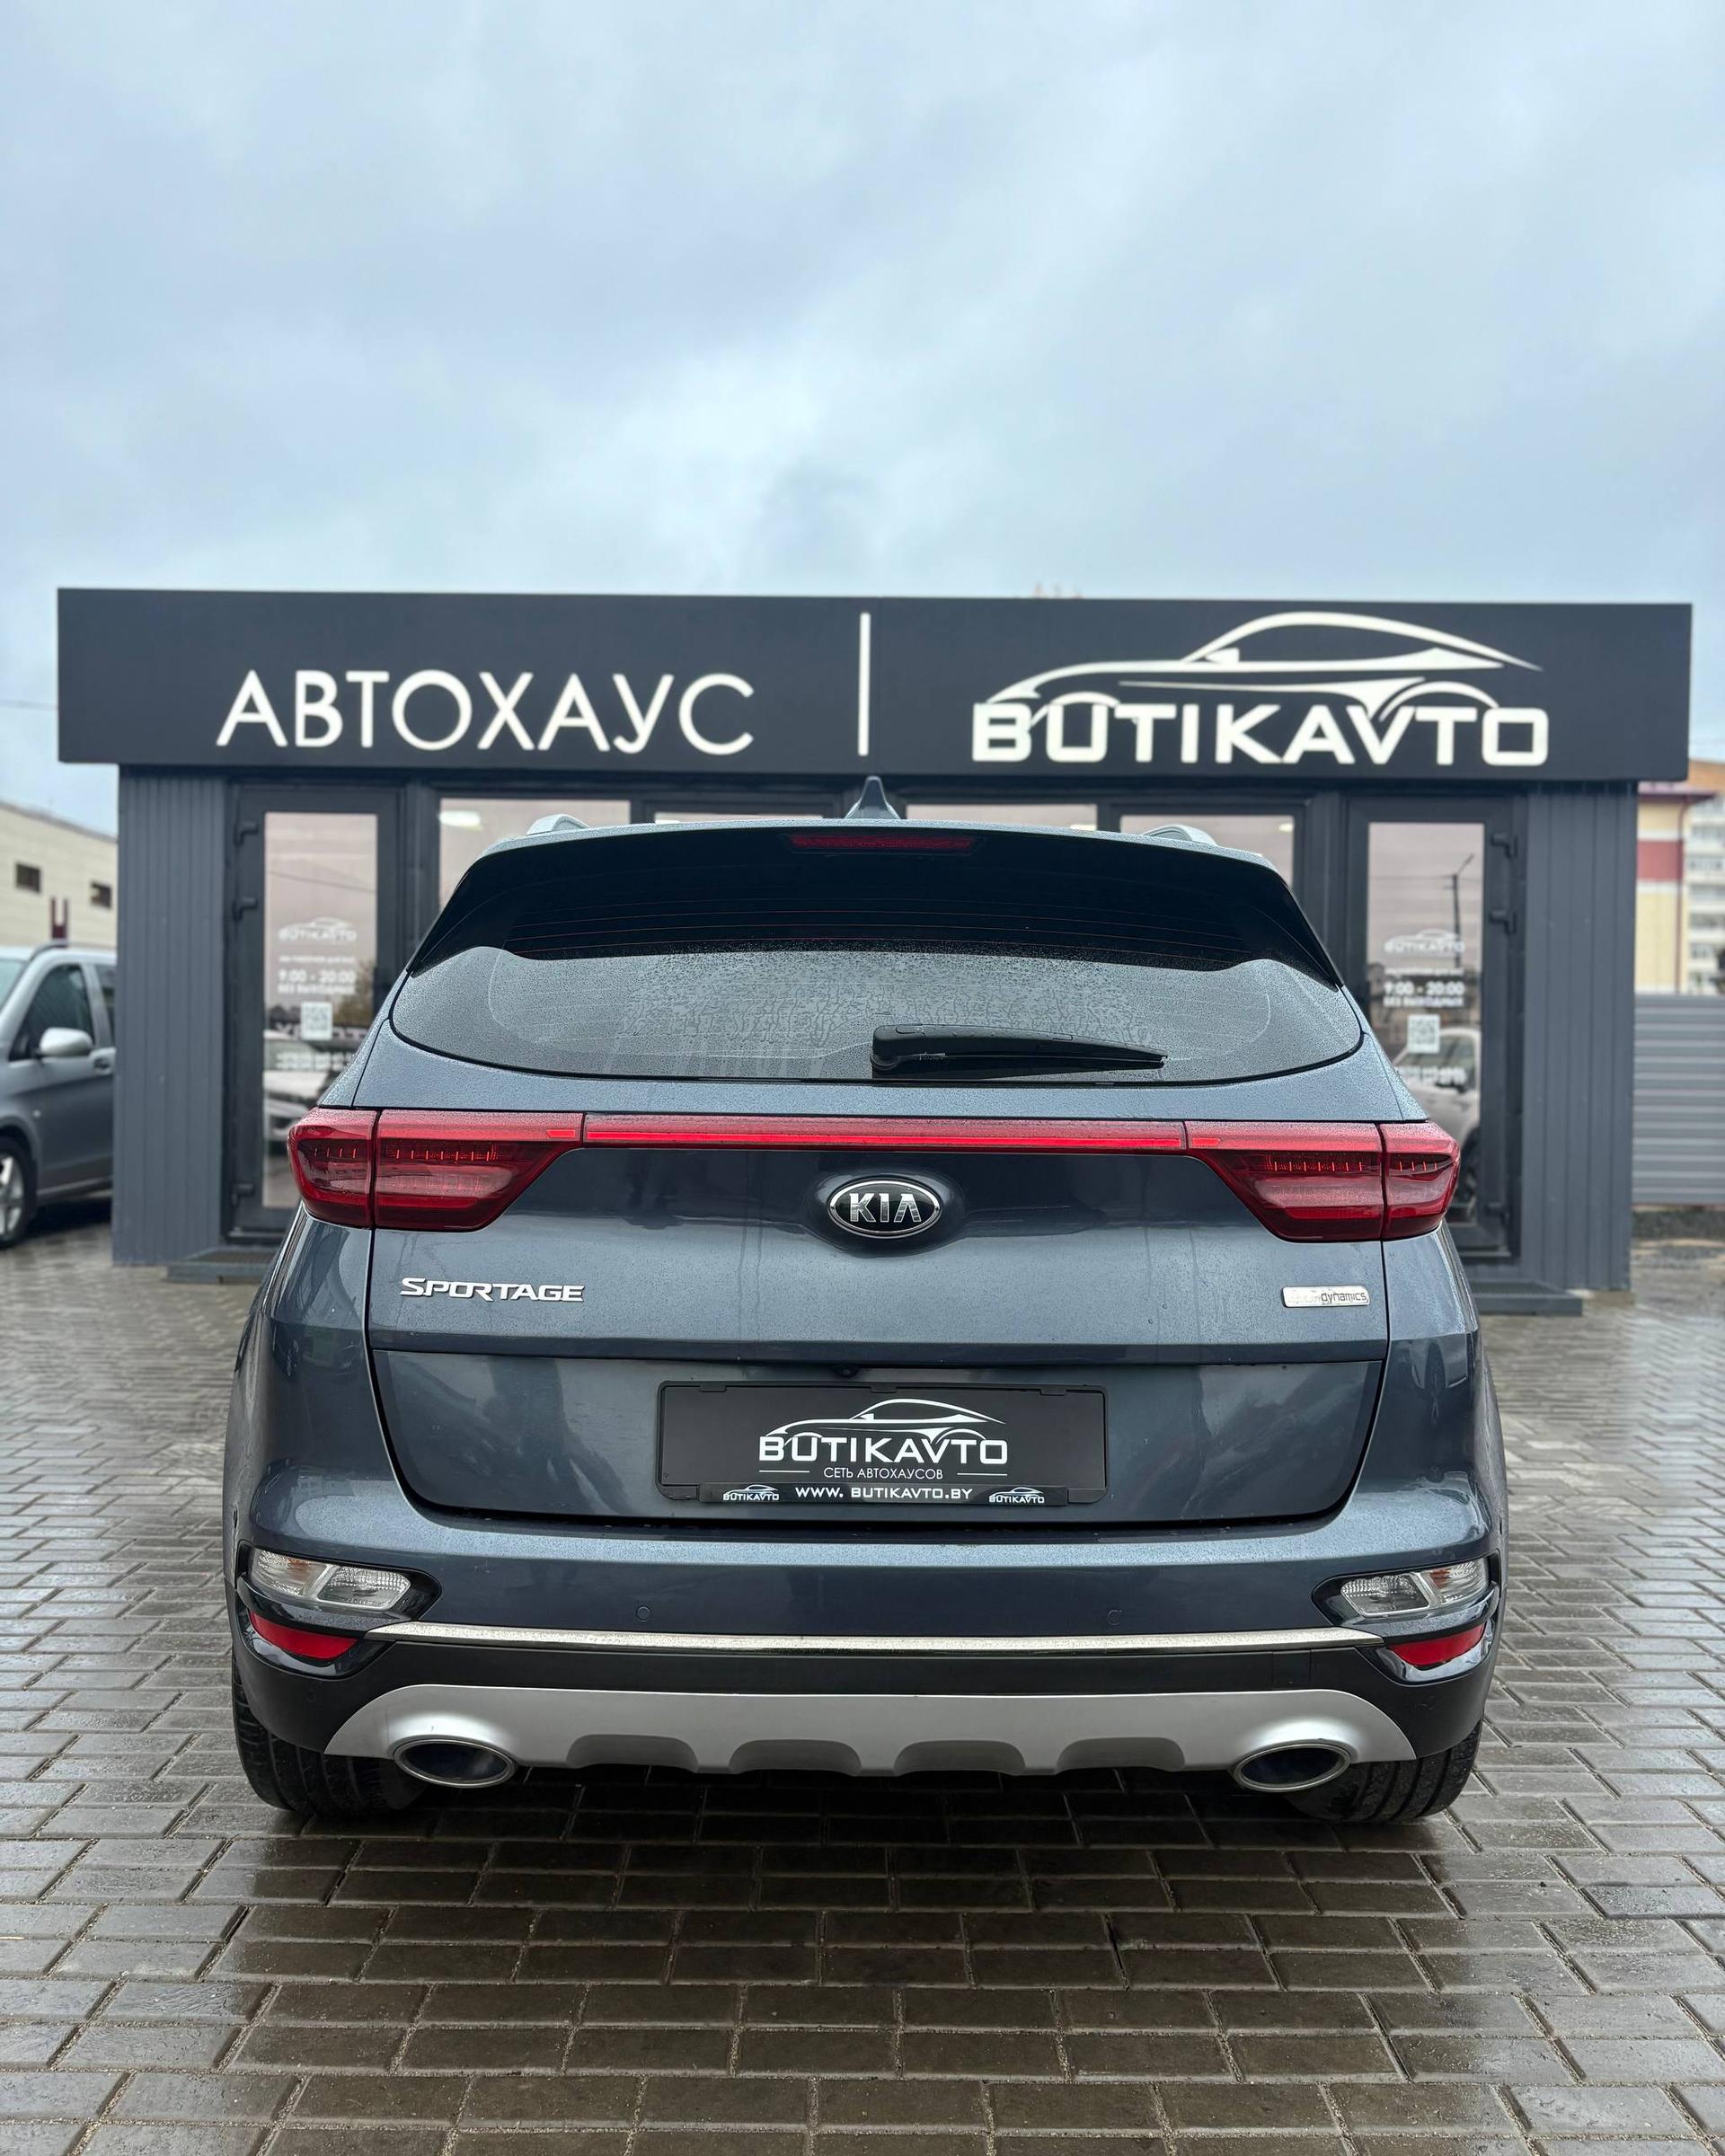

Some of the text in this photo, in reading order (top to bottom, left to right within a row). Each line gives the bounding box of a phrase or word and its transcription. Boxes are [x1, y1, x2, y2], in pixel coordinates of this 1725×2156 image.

[216, 669, 755, 755] АВТОХАУС
[971, 702, 1549, 766] BUTIKAVTO
[849, 1193, 922, 1223] KIA
[400, 1277, 585, 1302] SPORTAGE
[759, 1436, 1008, 1464] BUTIKAVTO
[824, 1467, 943, 1480] СЕТЬ АВТОХАУСОВ
[722, 1492, 780, 1501] BUTIKAVTO
[989, 1495, 1045, 1504] BUTIKAVTO
